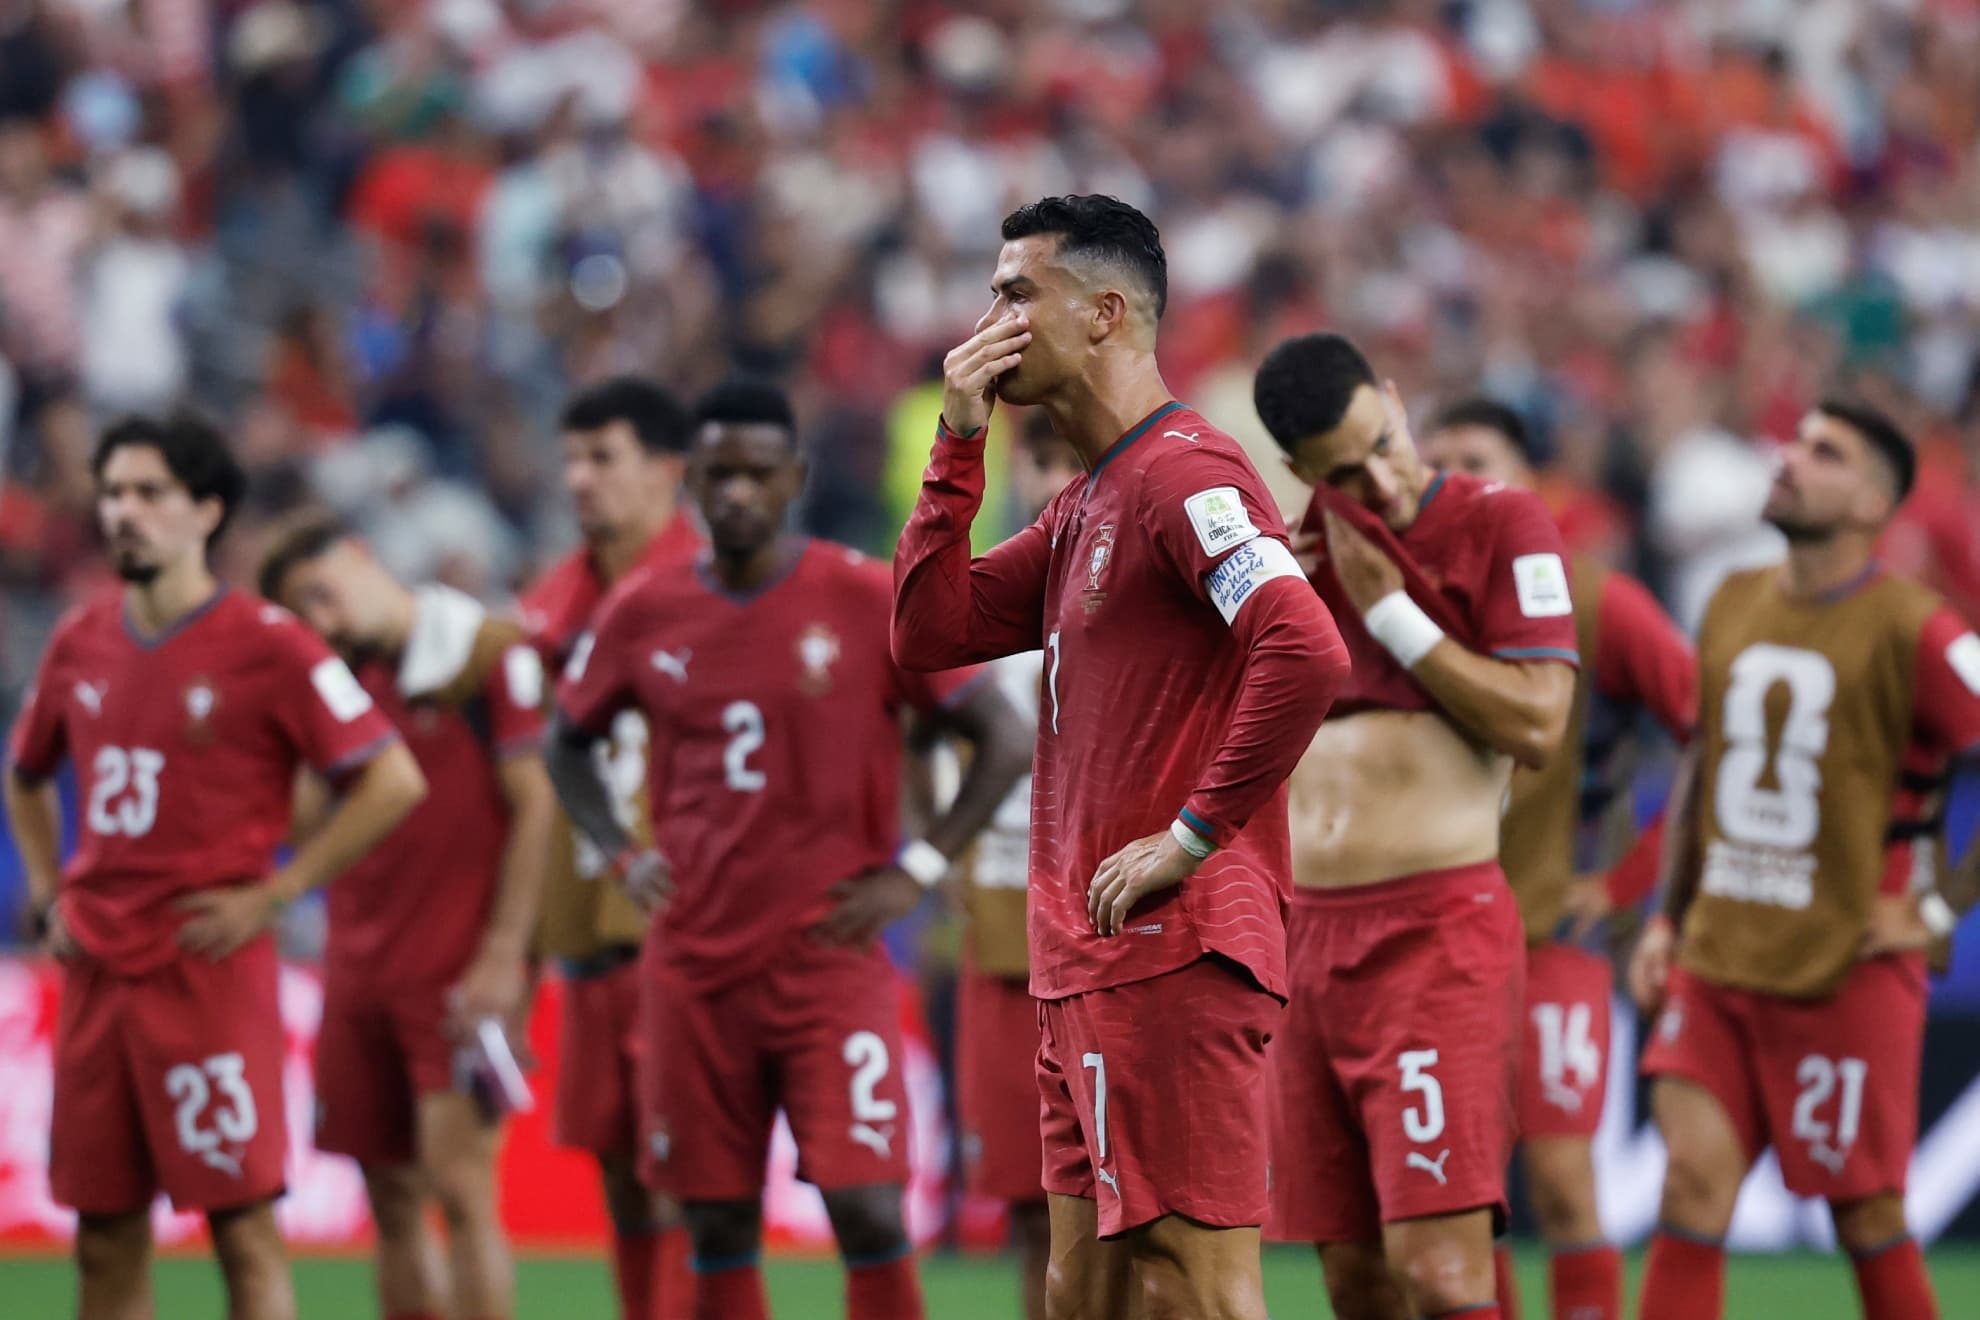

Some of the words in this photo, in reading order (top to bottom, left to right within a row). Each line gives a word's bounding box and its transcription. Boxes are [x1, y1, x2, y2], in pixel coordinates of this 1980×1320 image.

[1209, 547, 1256, 594] UNITES
[1229, 556, 1264, 590] World
[724, 701, 766, 791] 2
[88, 746, 164, 837] 23
[844, 1031, 897, 1121] 2
[1532, 1001, 1600, 1091] 14
[166, 1053, 258, 1152] 23
[1082, 1052, 1106, 1158] 7
[1397, 1048, 1446, 1143] 5
[1792, 1055, 1867, 1147] 21
